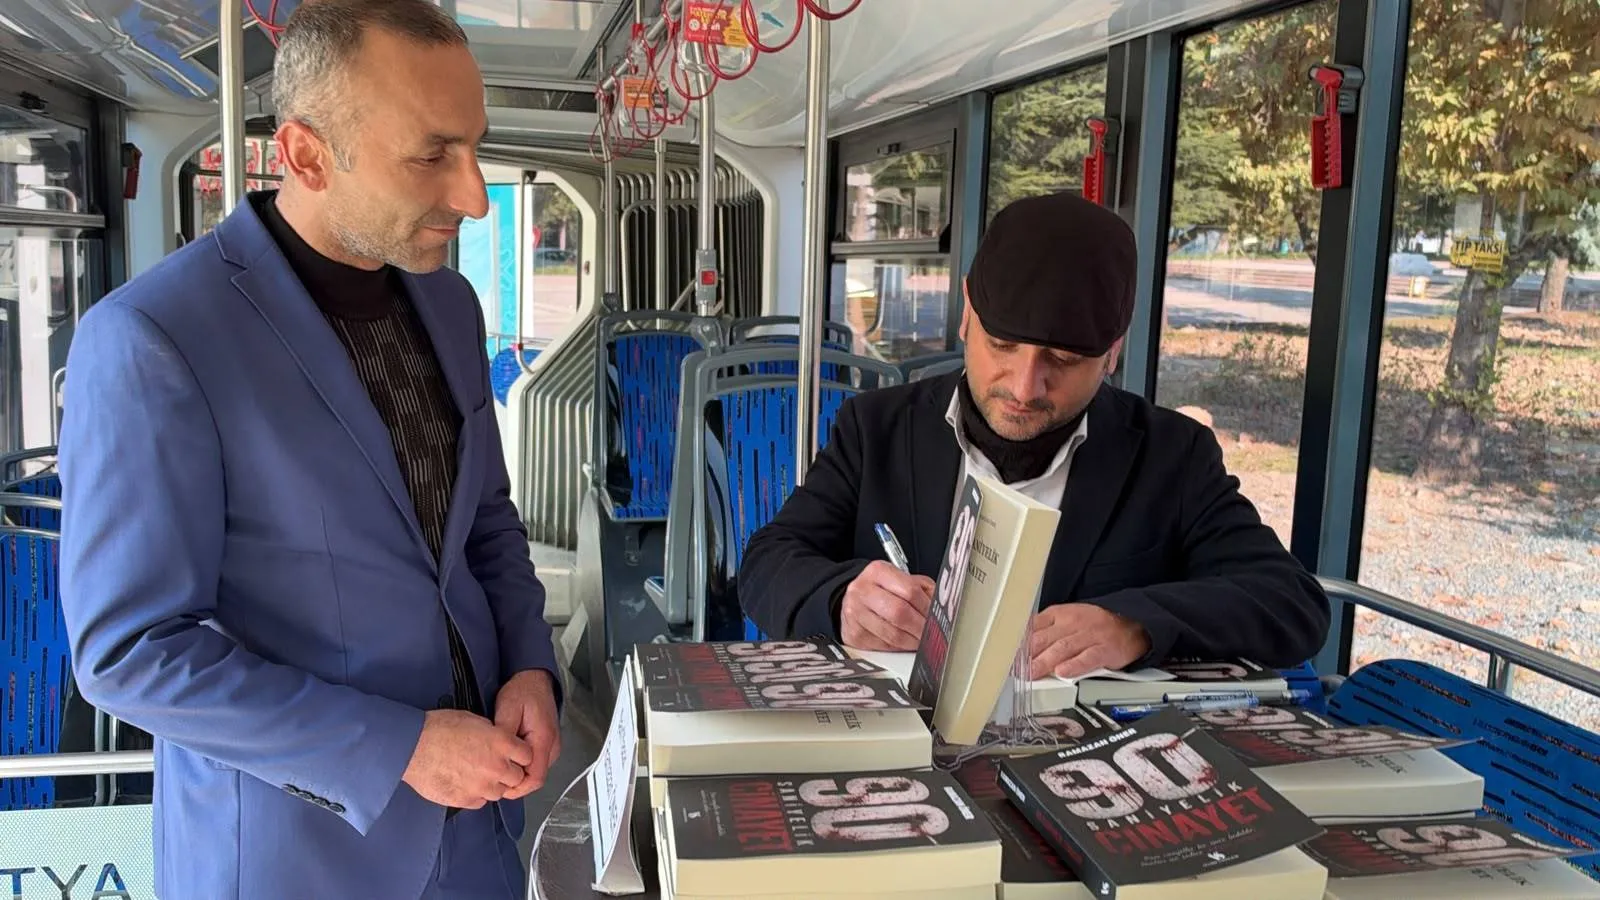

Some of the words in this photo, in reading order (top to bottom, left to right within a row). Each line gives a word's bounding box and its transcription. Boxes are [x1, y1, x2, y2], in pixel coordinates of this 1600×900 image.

[1039, 733, 1218, 820] 90
[1057, 738, 1109, 759] RAMAZAN
[799, 776, 950, 841] 90
